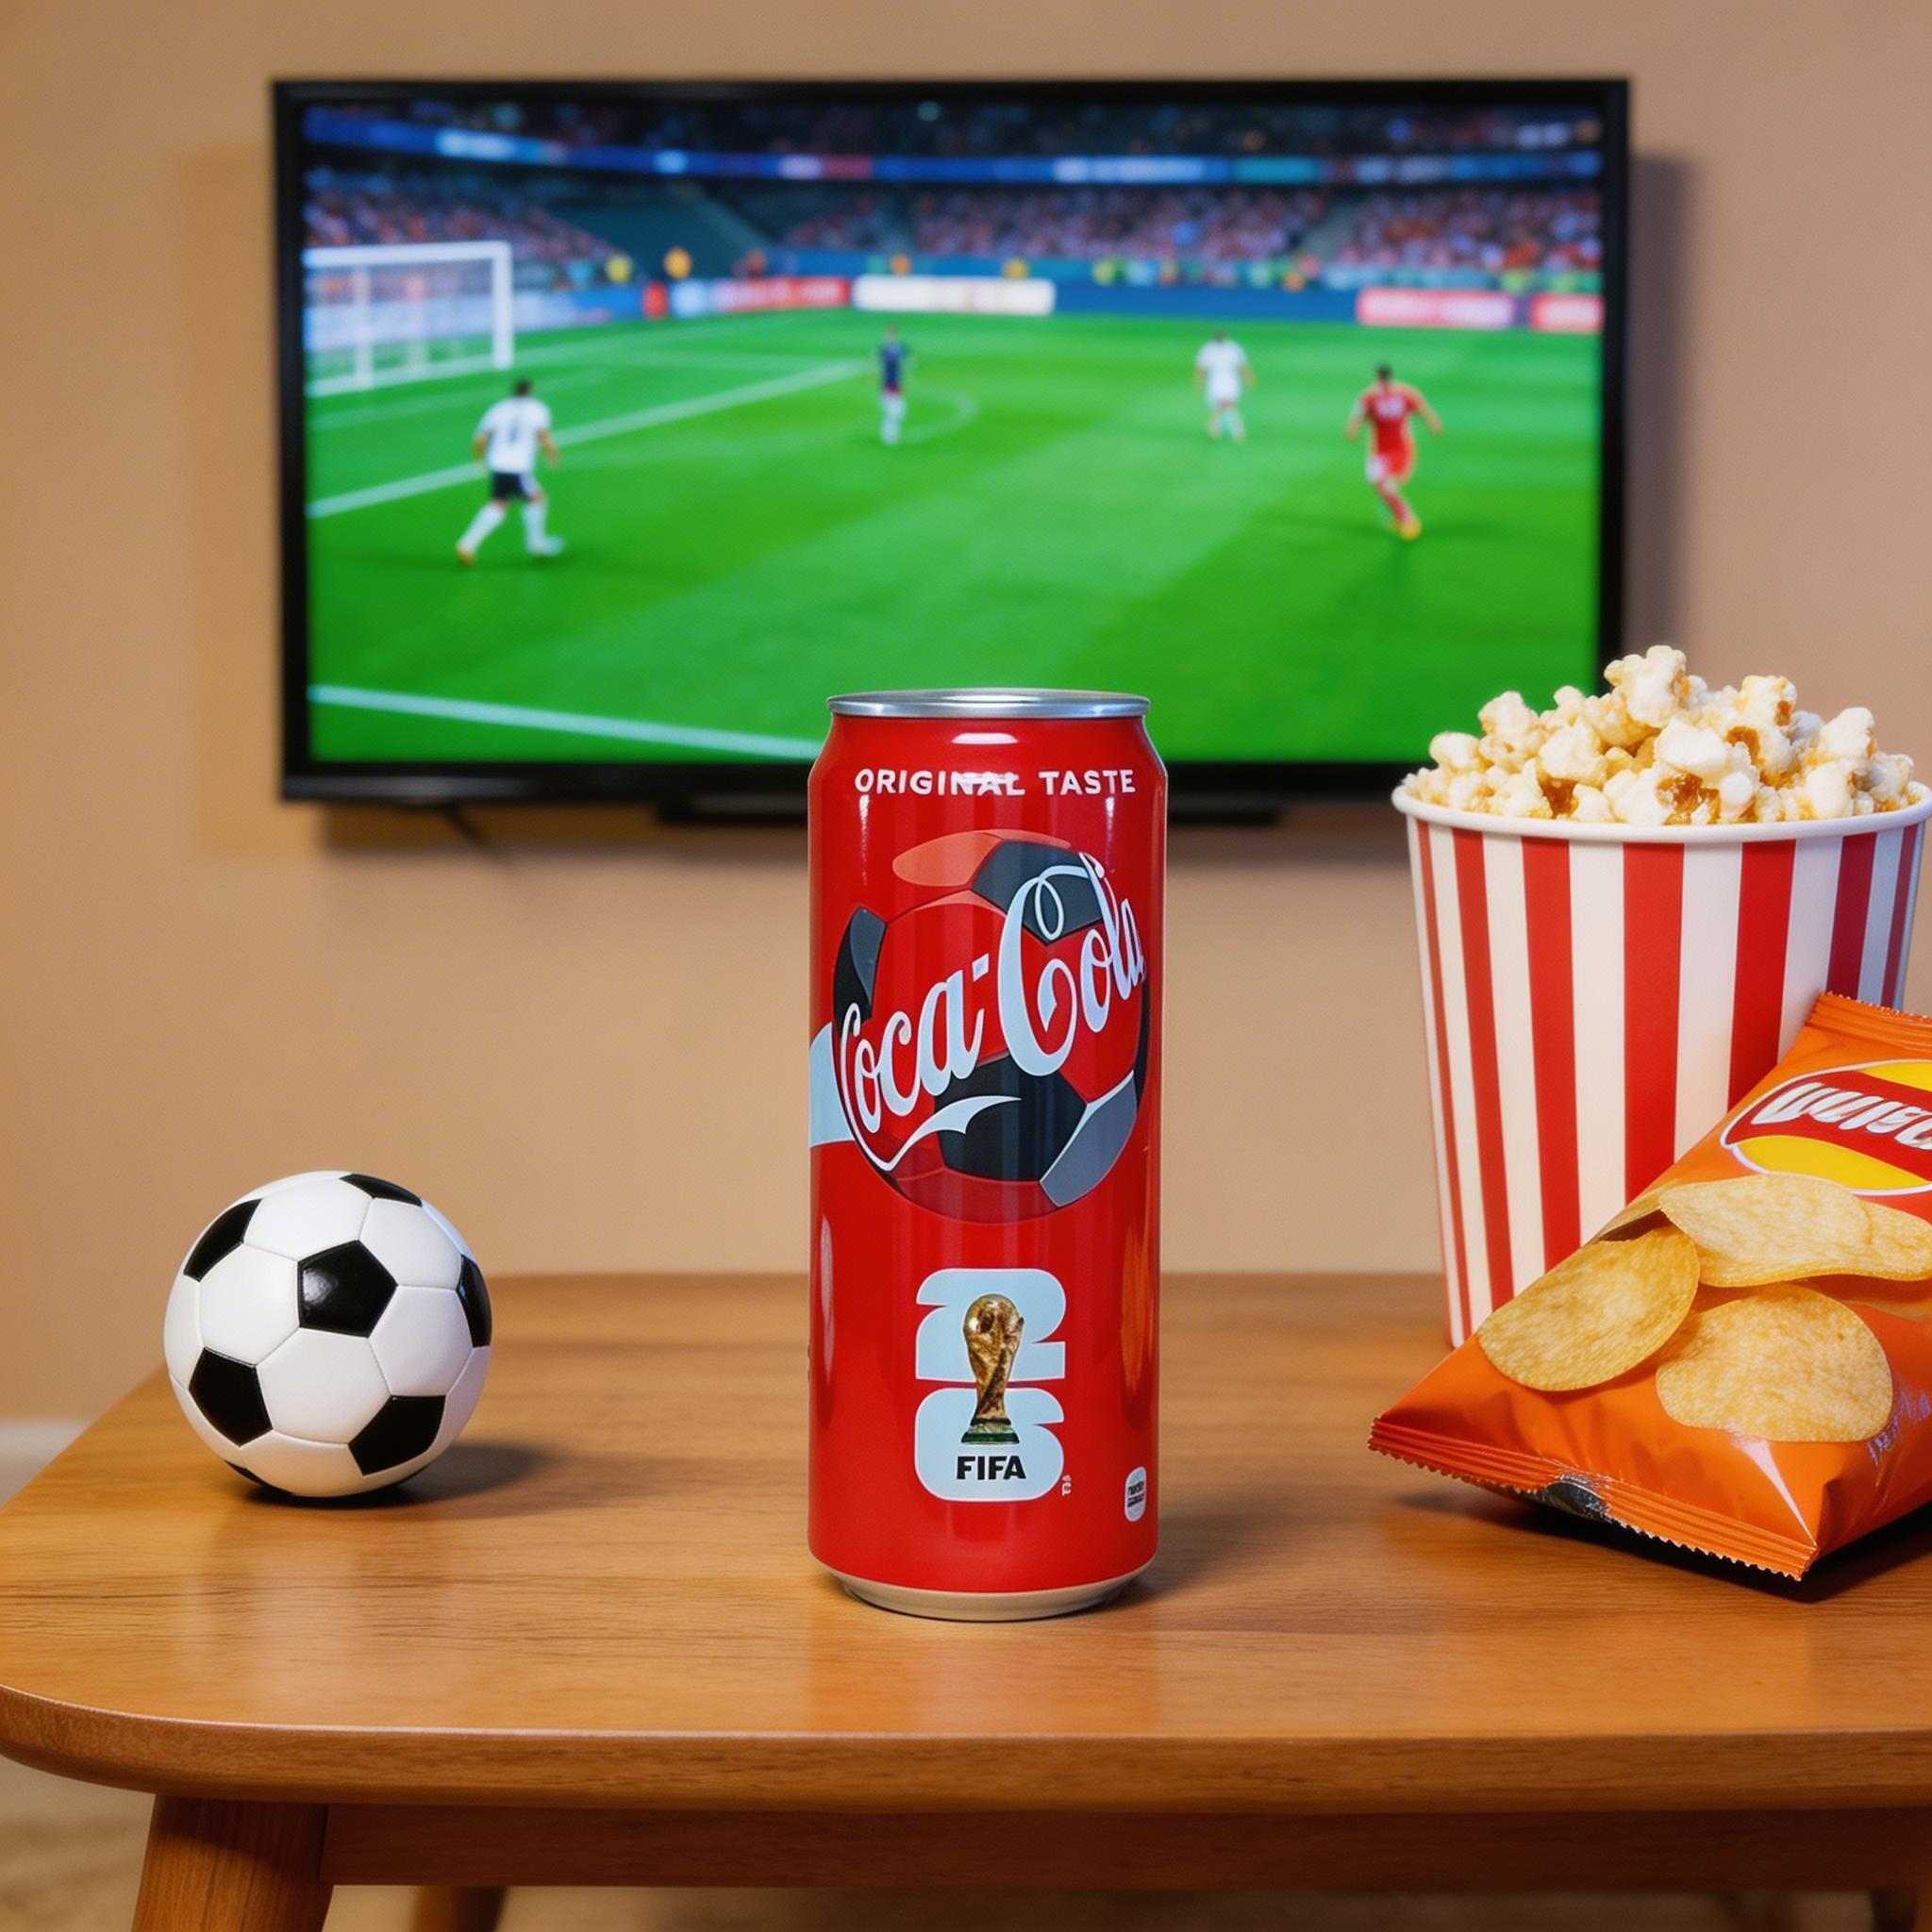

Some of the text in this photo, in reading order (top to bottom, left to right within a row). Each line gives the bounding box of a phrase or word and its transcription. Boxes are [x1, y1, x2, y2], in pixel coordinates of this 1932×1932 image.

[1038, 769, 1136, 795] TASTE
[840, 852, 1145, 1172] Coca-Cola
[956, 1455, 1026, 1480] FIFA
